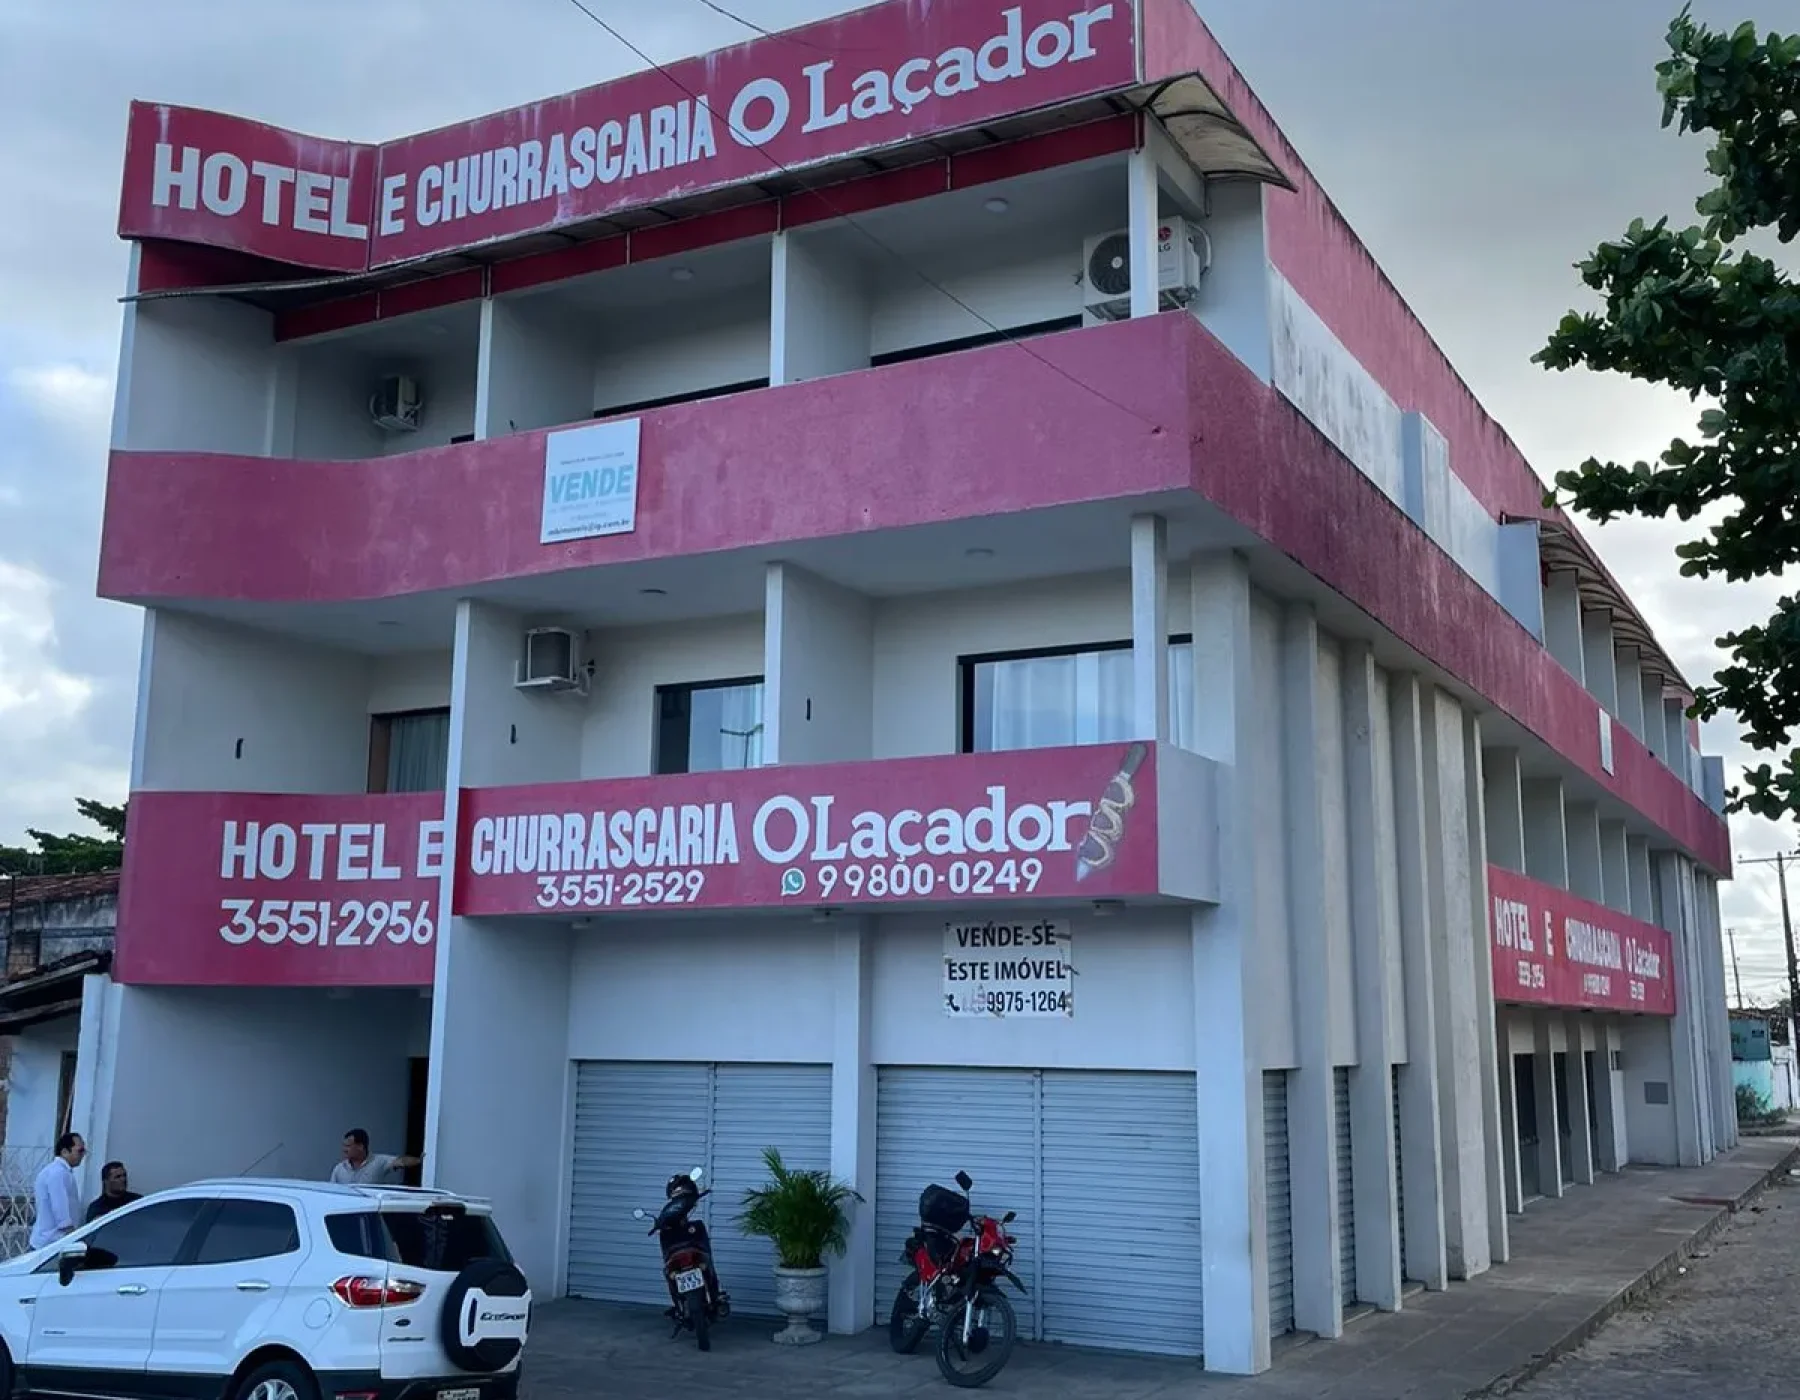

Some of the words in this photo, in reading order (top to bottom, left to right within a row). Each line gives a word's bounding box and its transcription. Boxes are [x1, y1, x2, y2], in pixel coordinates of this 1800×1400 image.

[152, 143, 367, 241] HOTEL
[380, 173, 407, 236] E
[416, 94, 717, 227] CHURRASCARIA
[728, 77, 791, 148] O
[801, 3, 1114, 133] Laçador
[550, 464, 634, 503] VENDE
[221, 820, 401, 881] HOTEL
[417, 820, 444, 878] E
[471, 802, 739, 874] CHURRASCARIA
[219, 899, 433, 946] 3551-2956
[956, 924, 1057, 948] VENDE-SE
[1494, 896, 1534, 952] HOTEL
[948, 962, 990, 981] ESTE
[995, 957, 1066, 981] IMÓVEL
